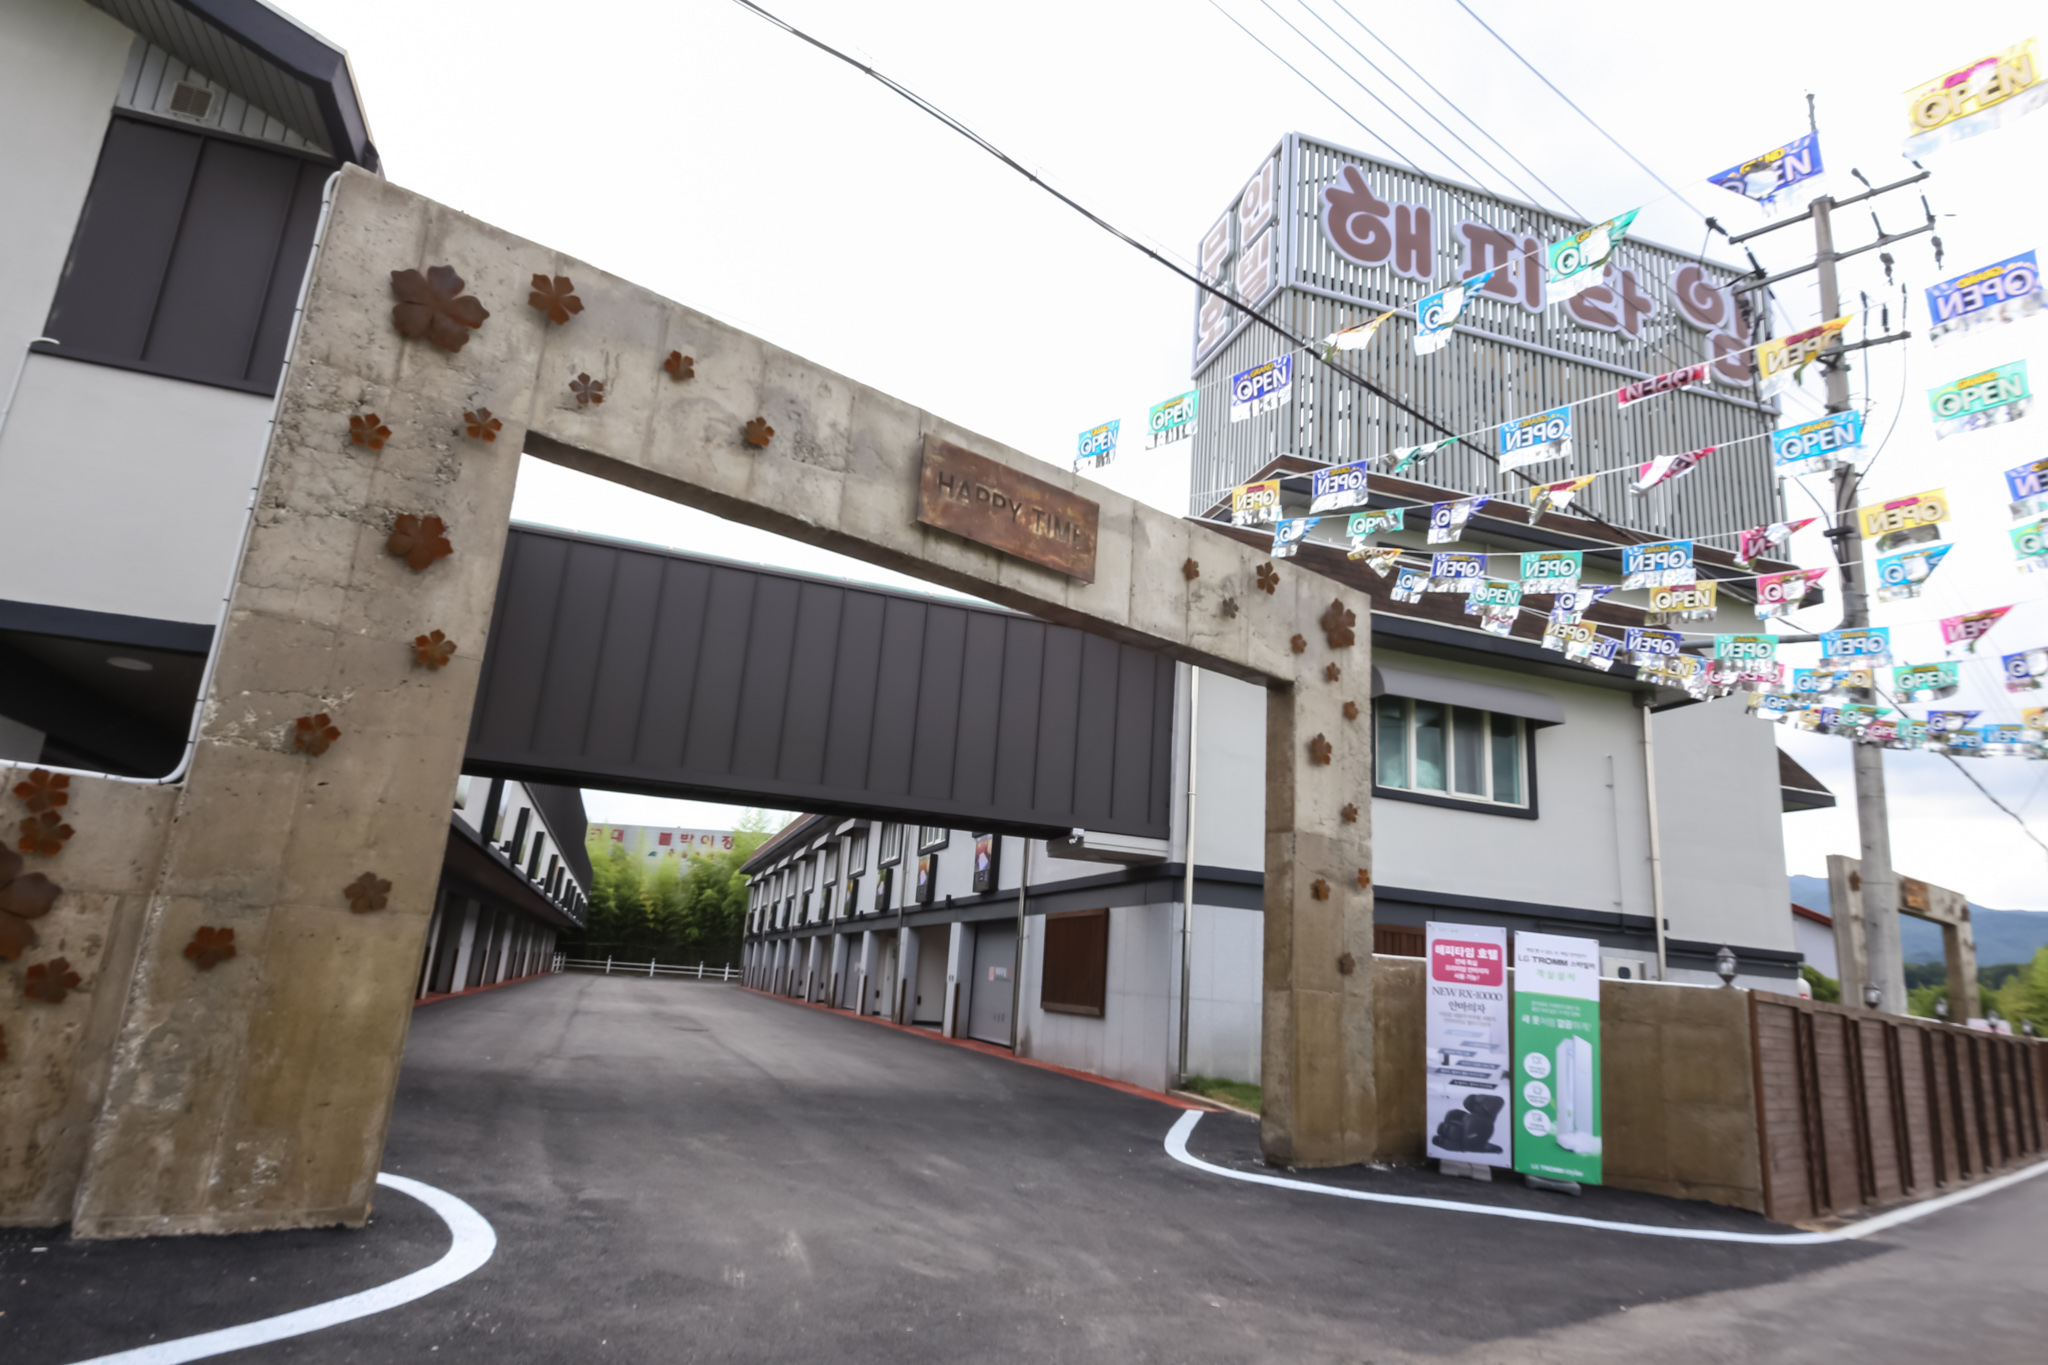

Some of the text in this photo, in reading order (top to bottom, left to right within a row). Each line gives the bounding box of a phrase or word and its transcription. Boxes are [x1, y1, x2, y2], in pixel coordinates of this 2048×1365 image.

[1915, 54, 2034, 128] OPEN
[1236, 365, 1288, 401] OPEN
[1936, 372, 2023, 416] OPEN
[1152, 396, 1194, 431] OPEN
[1080, 430, 1118, 456] OPEN
[1780, 423, 1856, 460] OPEN
[938, 471, 1022, 523] HAPPY
[1475, 586, 1519, 604] OPEN
[1656, 590, 1710, 609] OPEN
[1435, 945, 1475, 959] 해피타임
[1532, 956, 1568, 967] TROMM
[1432, 986, 1456, 997] NEW
